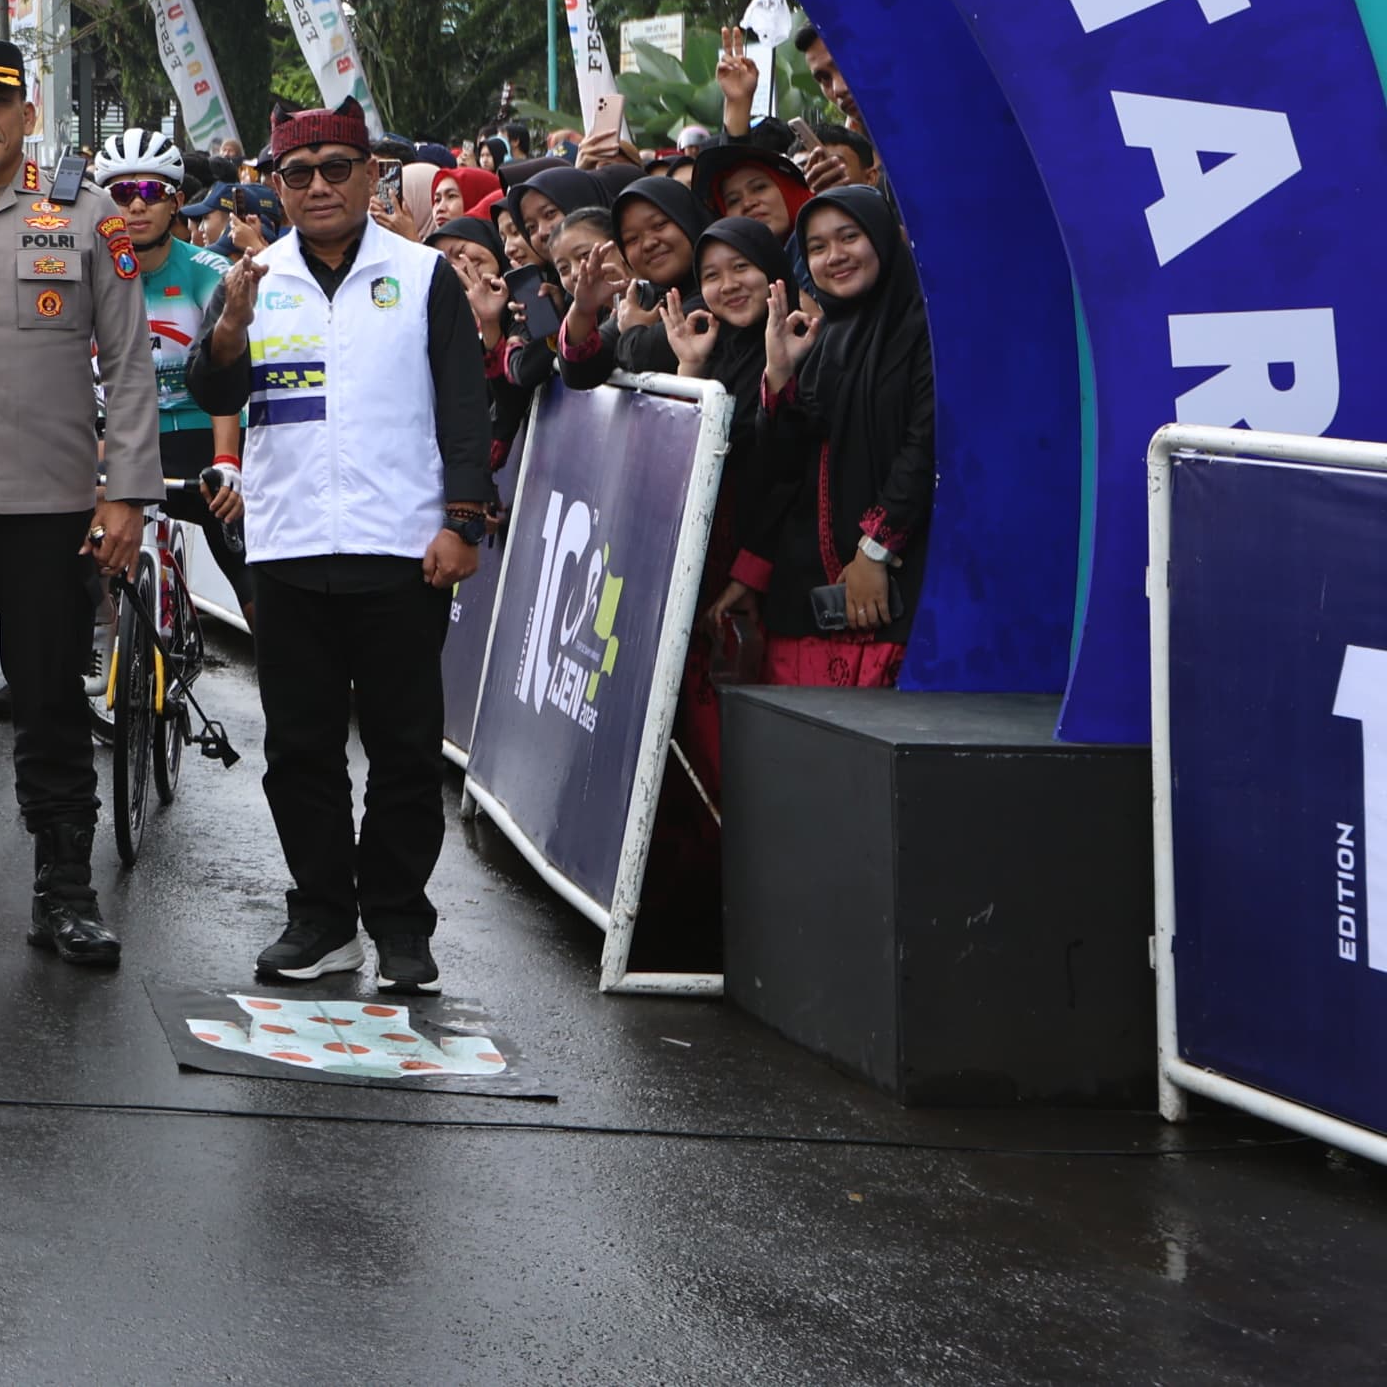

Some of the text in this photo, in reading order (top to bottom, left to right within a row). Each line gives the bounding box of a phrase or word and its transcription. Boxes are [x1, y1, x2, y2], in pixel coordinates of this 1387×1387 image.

[22, 234, 75, 249] POLRI
[190, 250, 228, 274] ANTA
[579, 702, 599, 734] 2025
[1336, 820, 1356, 963] EDITION
